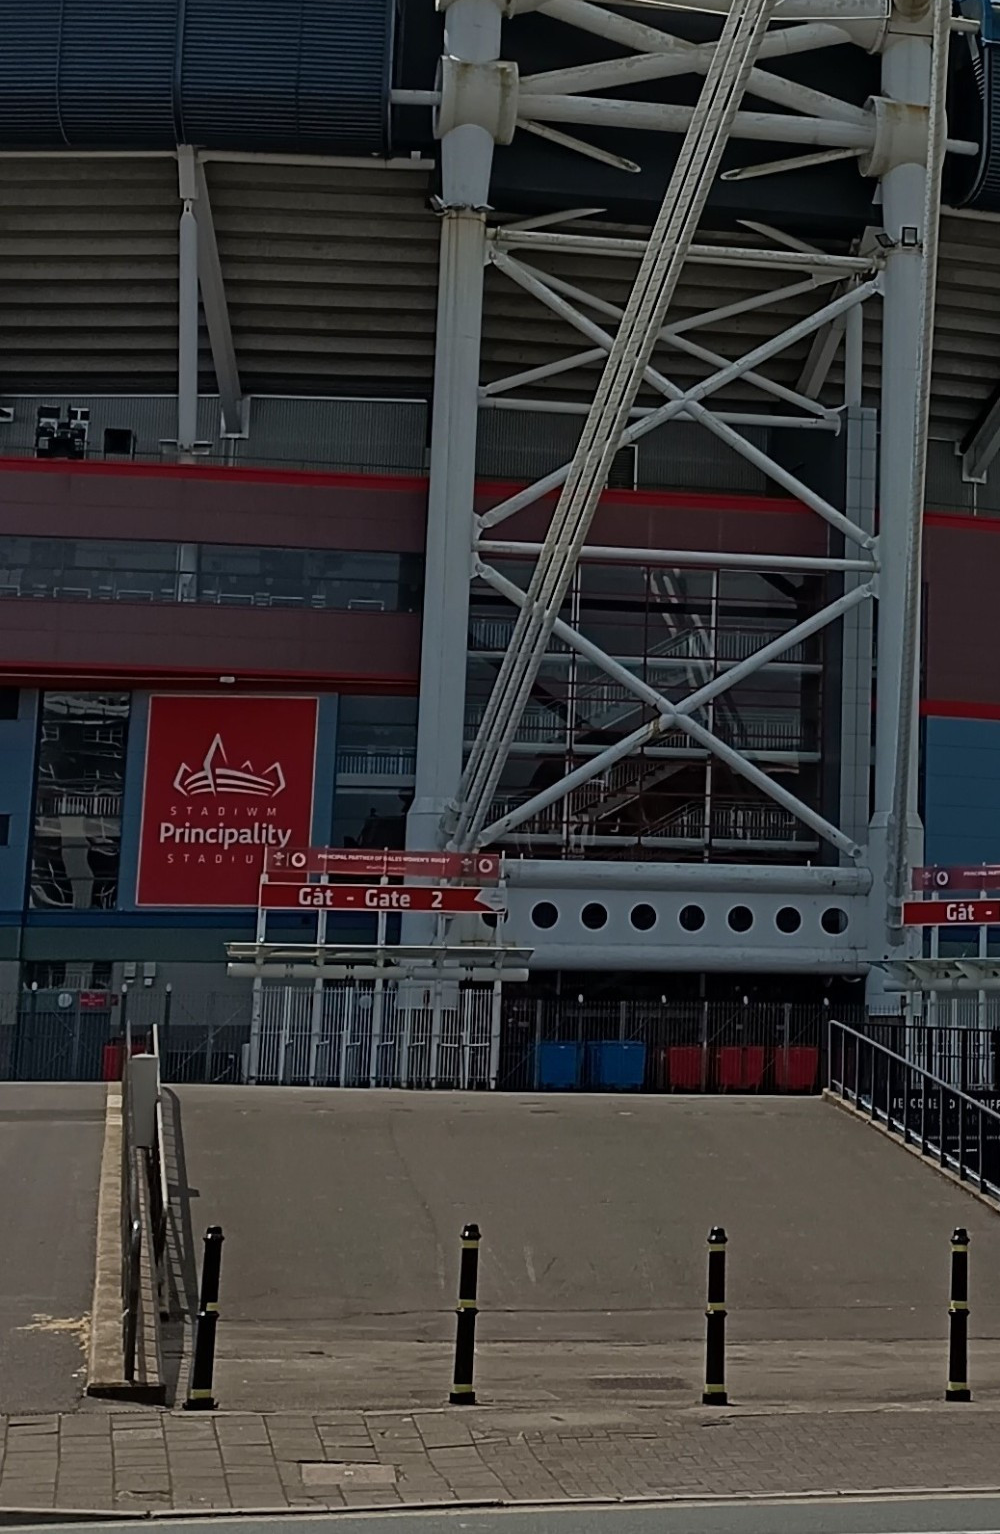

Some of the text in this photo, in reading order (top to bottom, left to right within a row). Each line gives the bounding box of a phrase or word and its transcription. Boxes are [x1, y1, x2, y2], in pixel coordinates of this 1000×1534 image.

[169, 806, 277, 817] STADIWM
[159, 822, 292, 850] Principality
[166, 854, 255, 864] STADIU
[298, 887, 333, 905] Gât
[365, 889, 411, 906] Gate
[431, 891, 443, 907] 2
[946, 903, 975, 921] Gât
